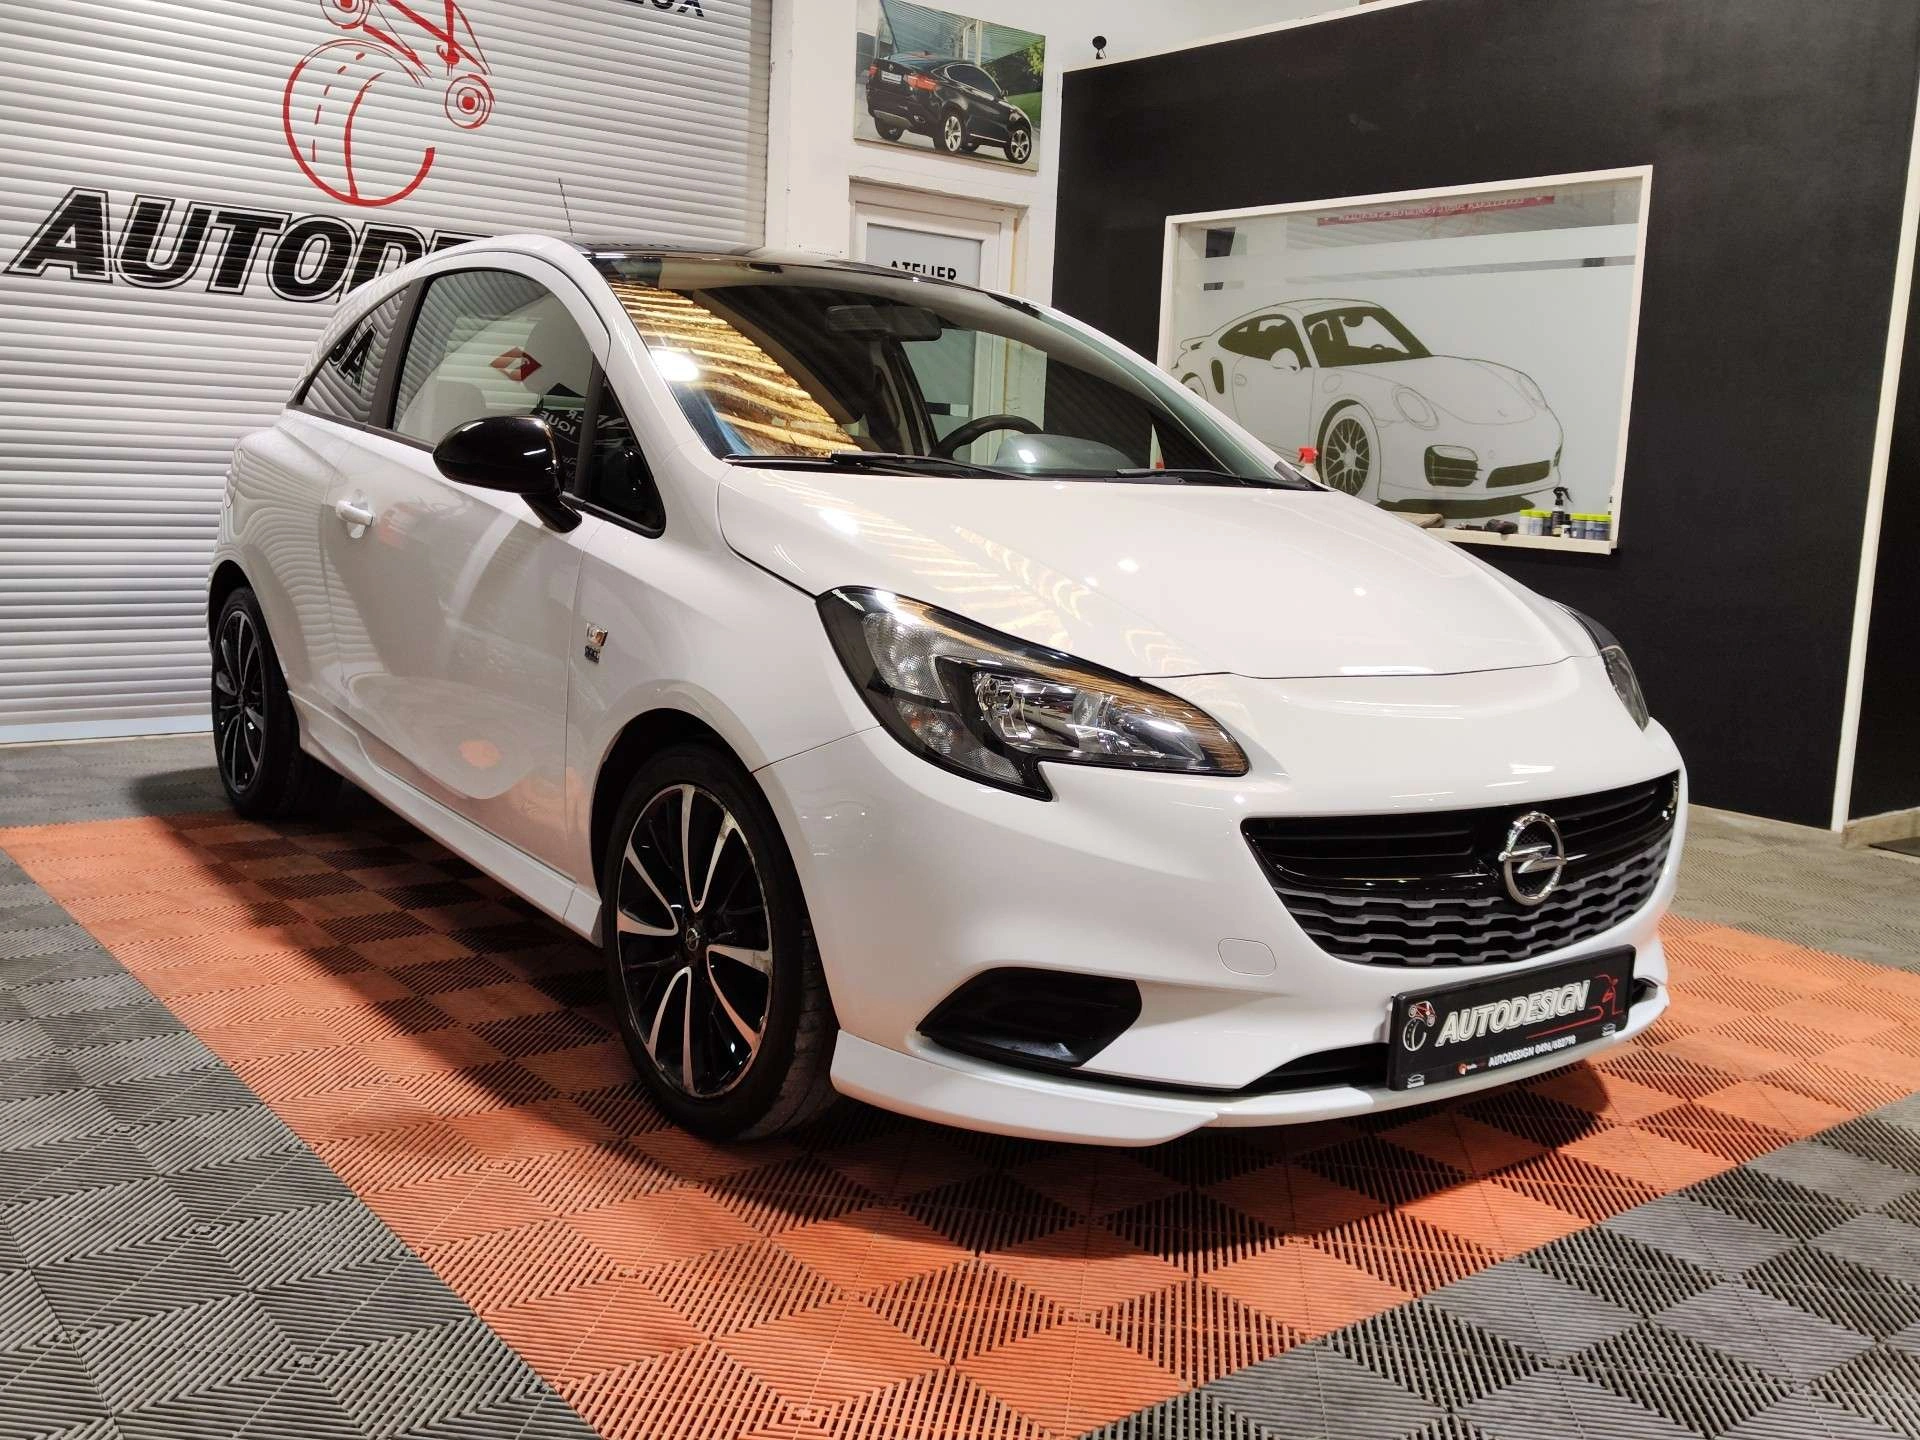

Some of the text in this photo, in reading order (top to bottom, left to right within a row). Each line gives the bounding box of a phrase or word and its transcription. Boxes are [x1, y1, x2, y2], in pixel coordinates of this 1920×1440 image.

[2, 186, 497, 304] AUTOD
[1434, 979, 1591, 1047] AUTODESIGN
[1488, 1046, 1535, 1067] AUTODESIGN
